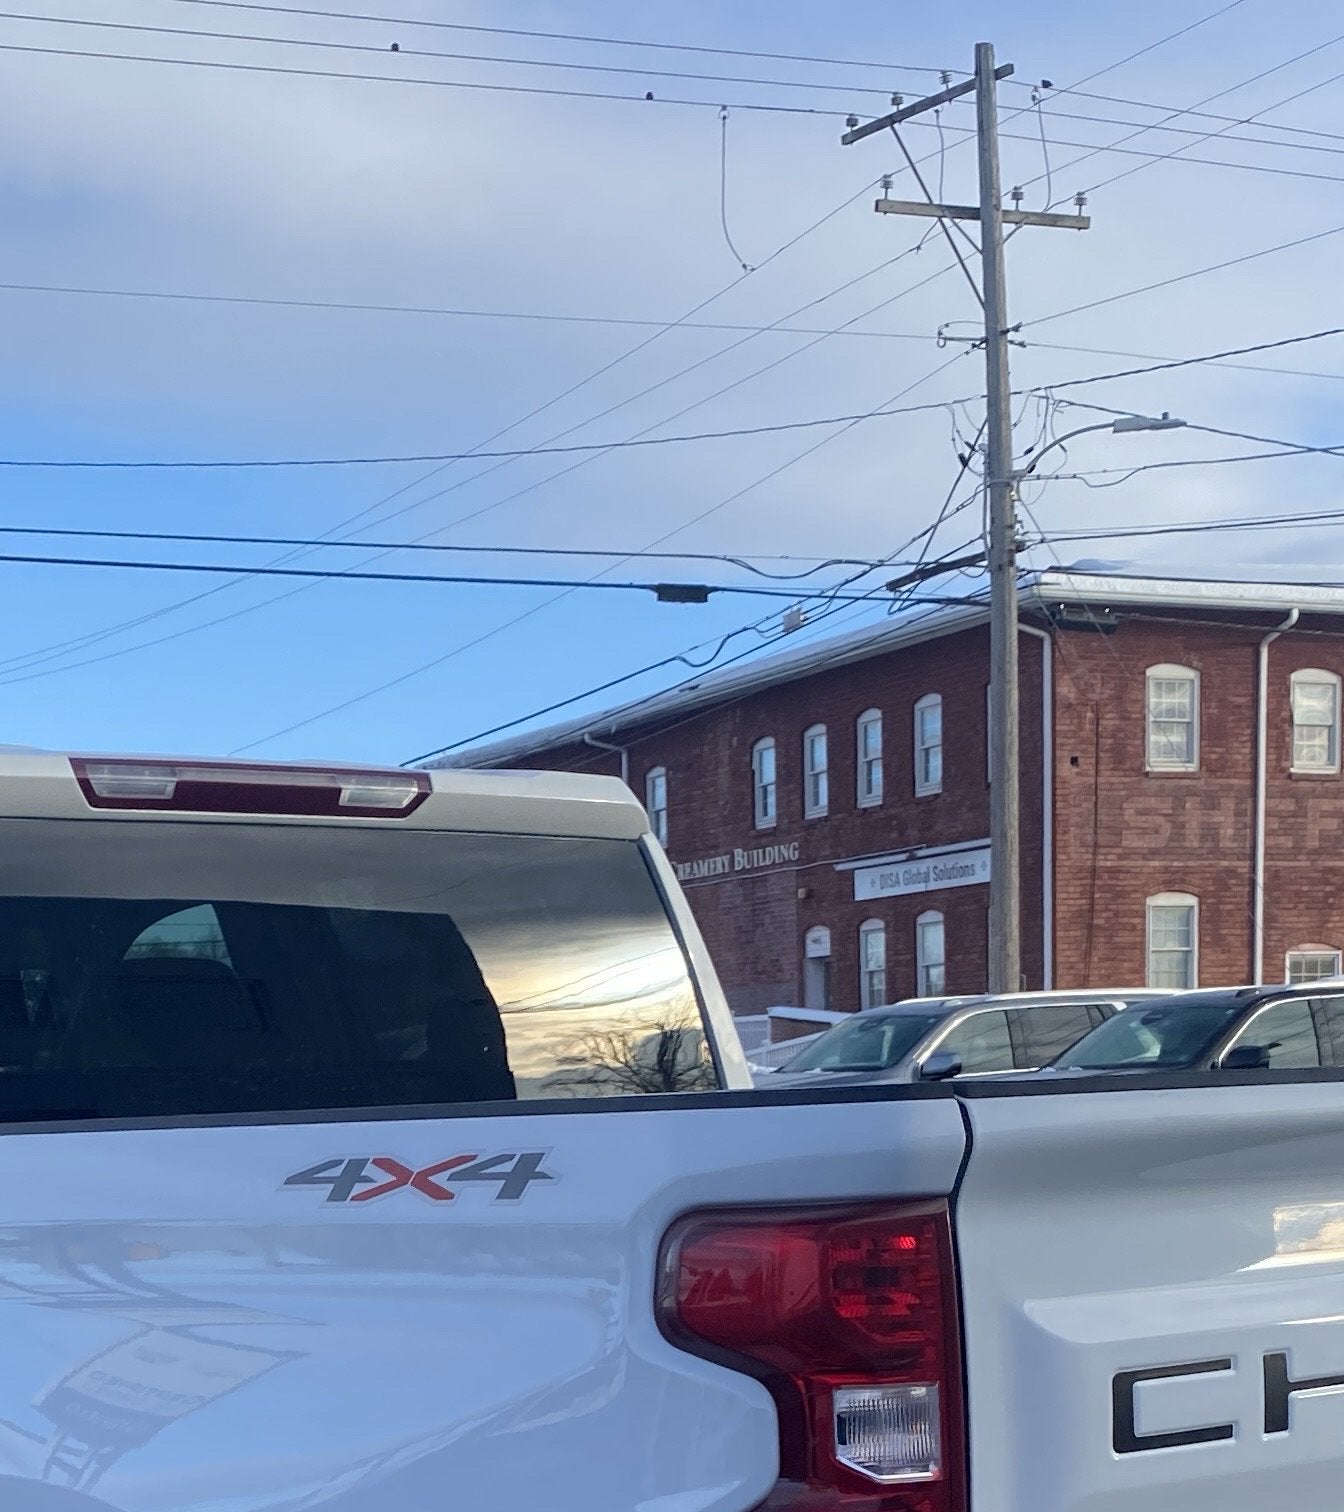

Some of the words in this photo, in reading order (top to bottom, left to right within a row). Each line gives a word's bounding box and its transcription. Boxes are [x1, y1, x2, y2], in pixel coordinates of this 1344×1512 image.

[879, 871, 902, 890] DISA
[902, 863, 931, 886] Global
[932, 860, 976, 882] Solutions
